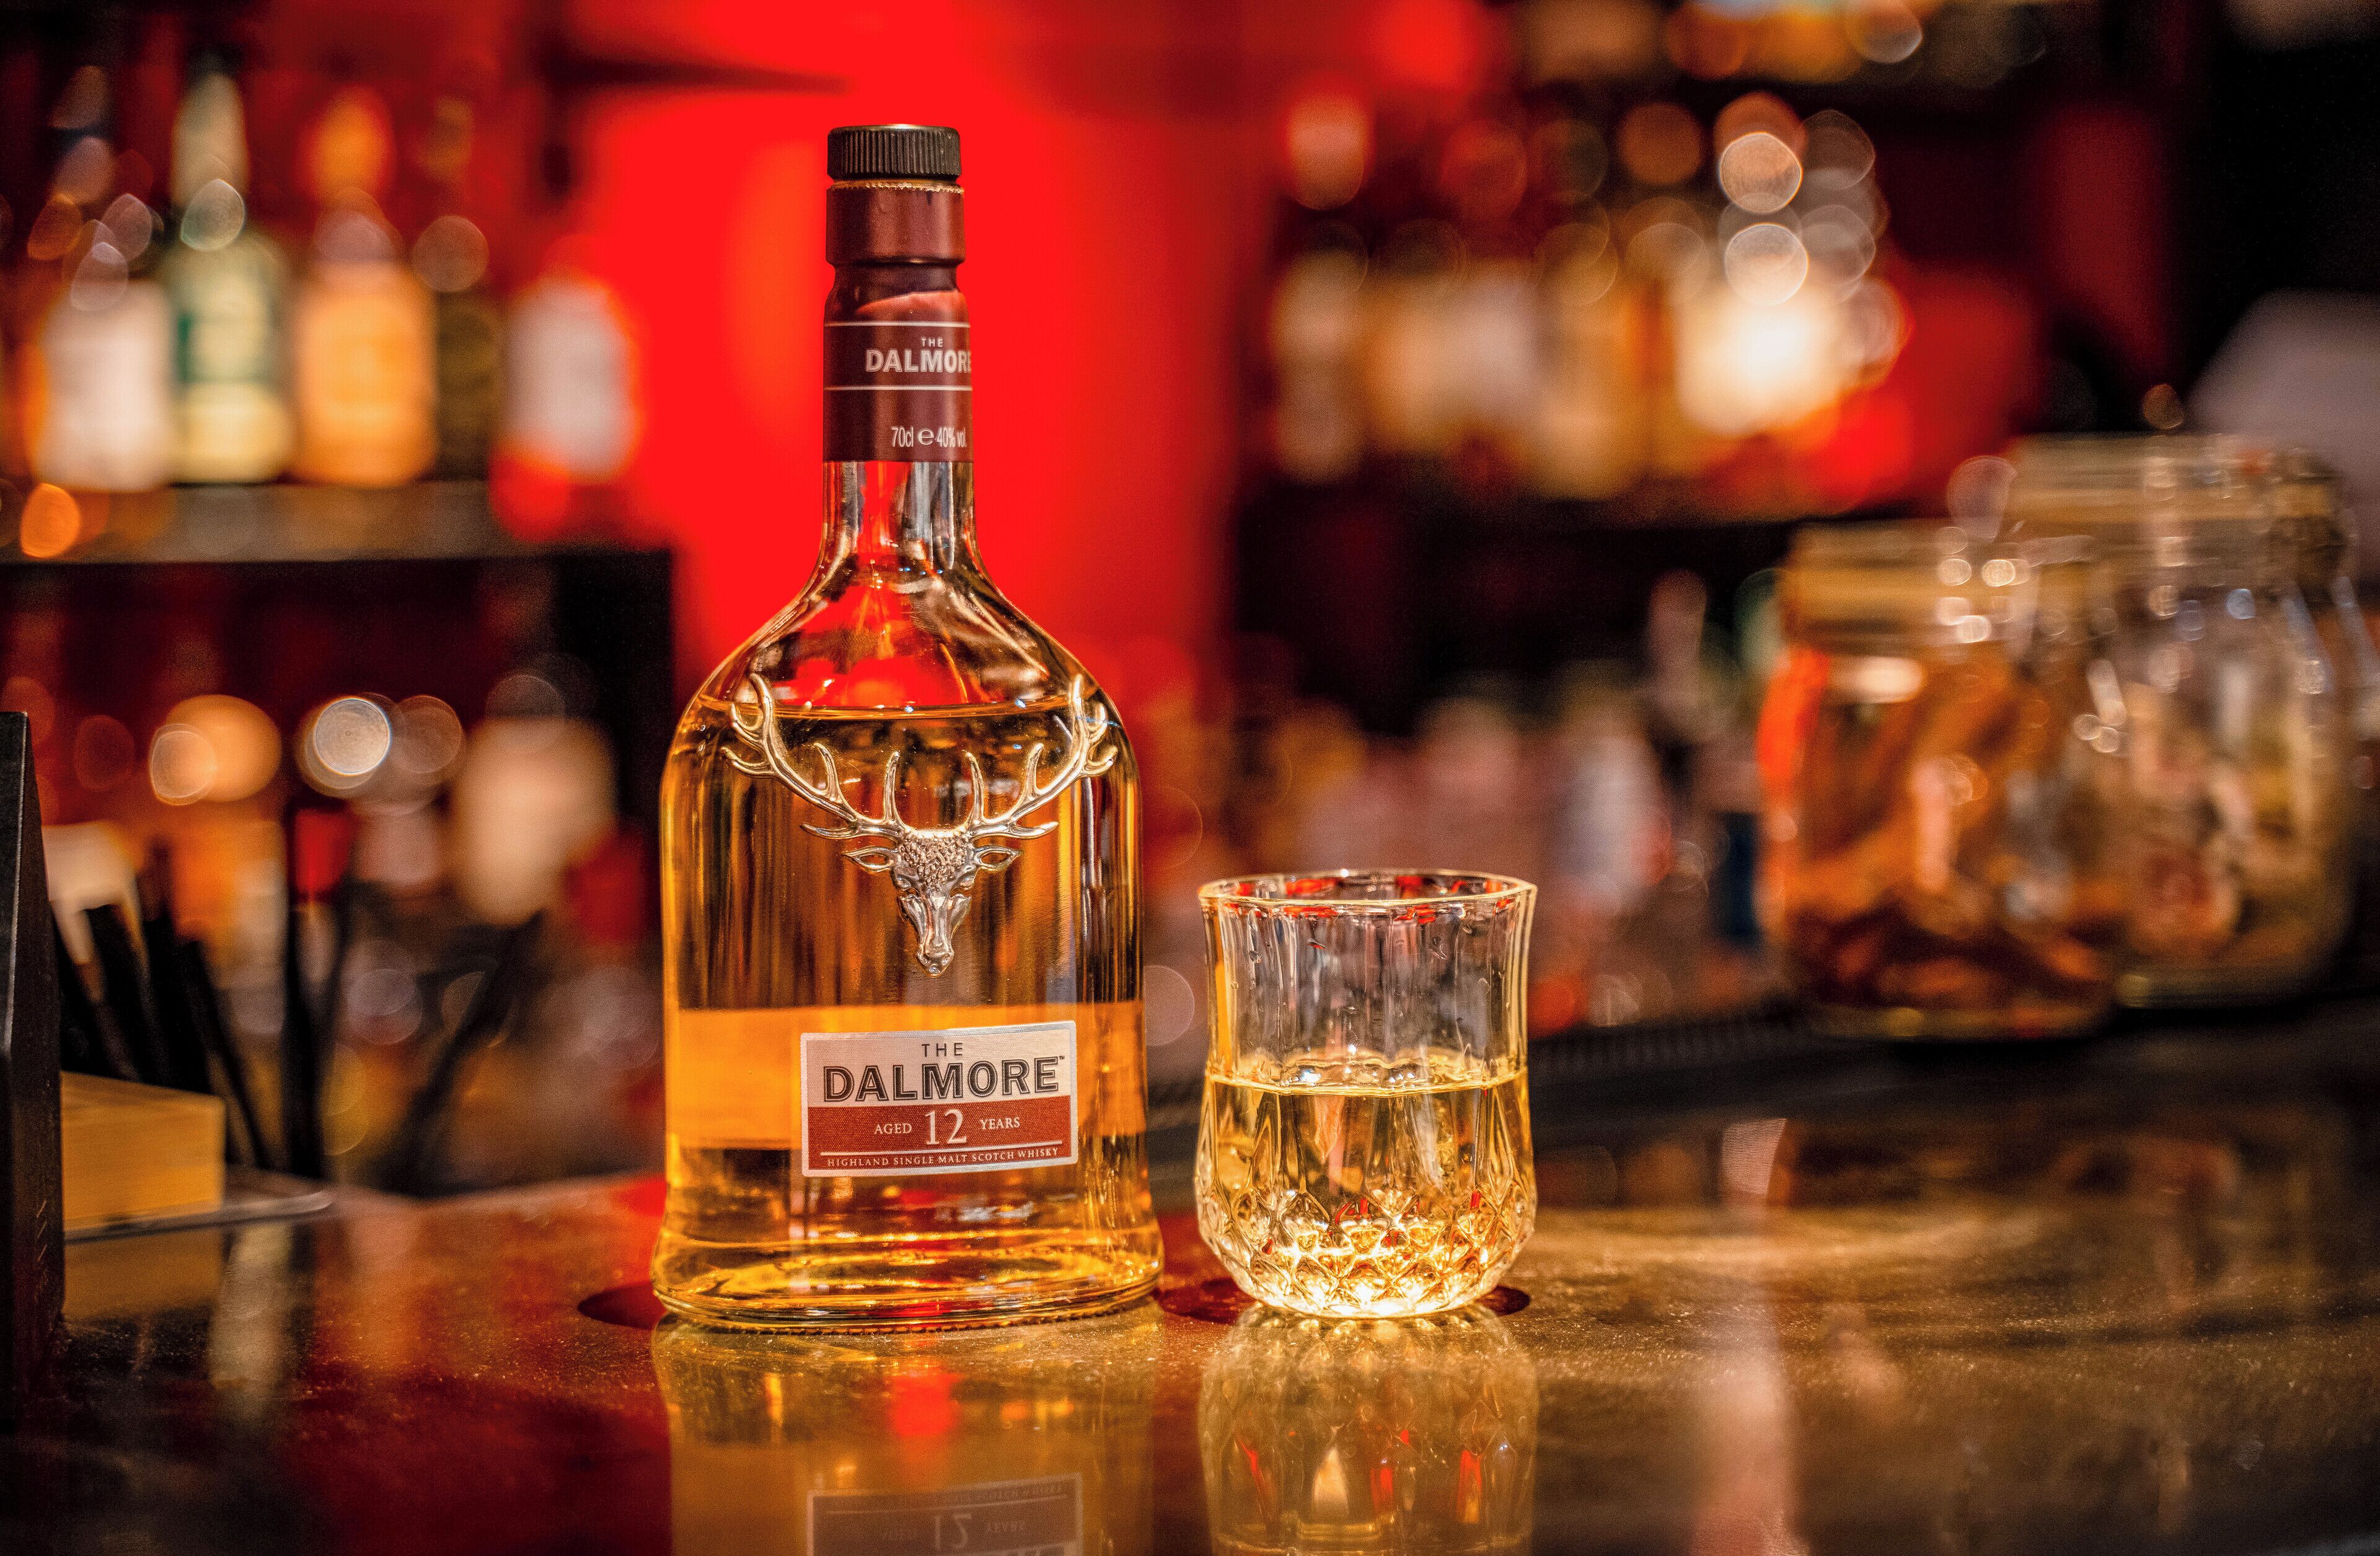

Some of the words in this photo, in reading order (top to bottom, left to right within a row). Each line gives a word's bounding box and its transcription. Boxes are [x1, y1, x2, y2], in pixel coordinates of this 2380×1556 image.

[921, 338, 943, 347] THE
[891, 426, 914, 447] 70cl
[937, 428, 956, 447] 40%
[922, 1042, 963, 1057] THE
[823, 1057, 1059, 1102] DALMORE
[874, 1123, 912, 1135] AGED
[925, 1109, 967, 1145] 12
[980, 1117, 1020, 1130] YEARS
[827, 1158, 889, 1166] HIGHLAND
[894, 1156, 934, 1165] SINGLE
[938, 1154, 967, 1163] MALT
[972, 1151, 1014, 1162] SCOTCH
[1018, 1148, 1059, 1158] WHISKY
